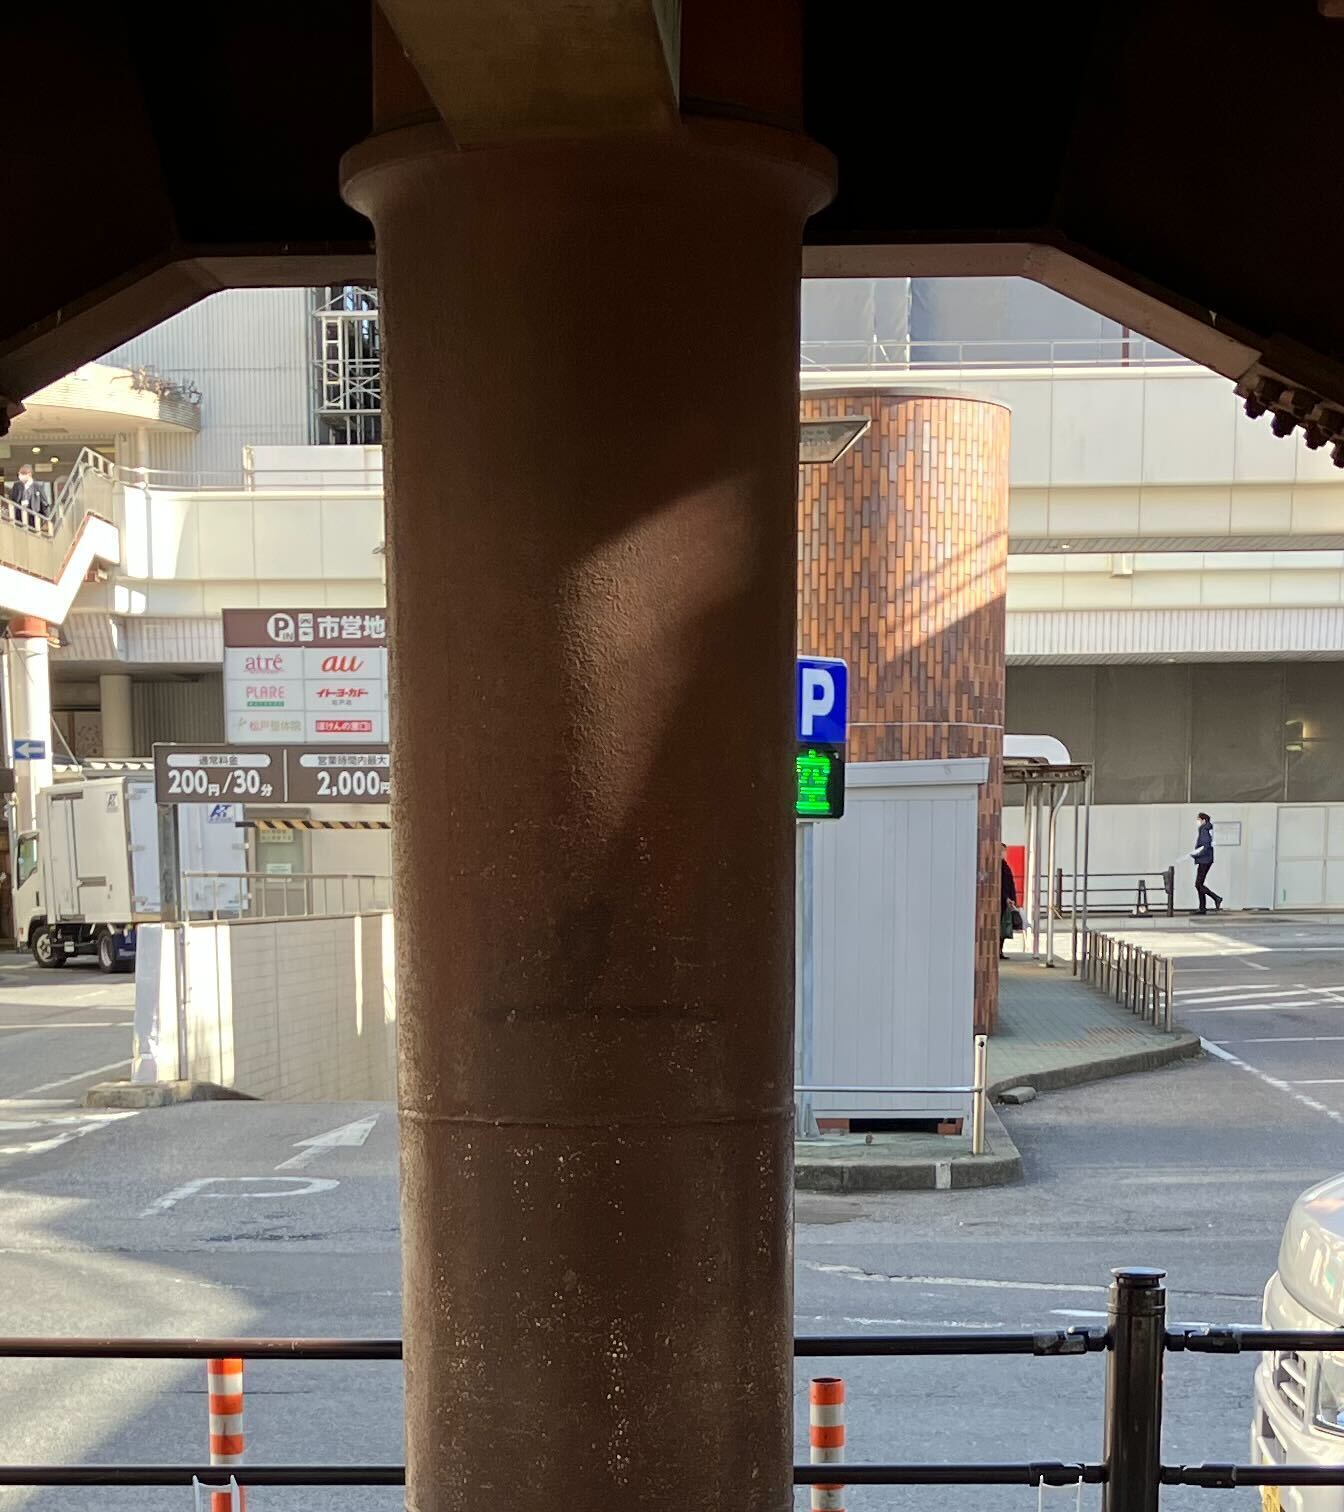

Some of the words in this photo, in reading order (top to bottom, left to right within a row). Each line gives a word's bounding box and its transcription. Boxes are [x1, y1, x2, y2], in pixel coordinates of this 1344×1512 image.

[245, 654, 283, 671] atré
[321, 655, 364, 672] au
[246, 686, 285, 699] PLARE
[801, 668, 835, 736] P
